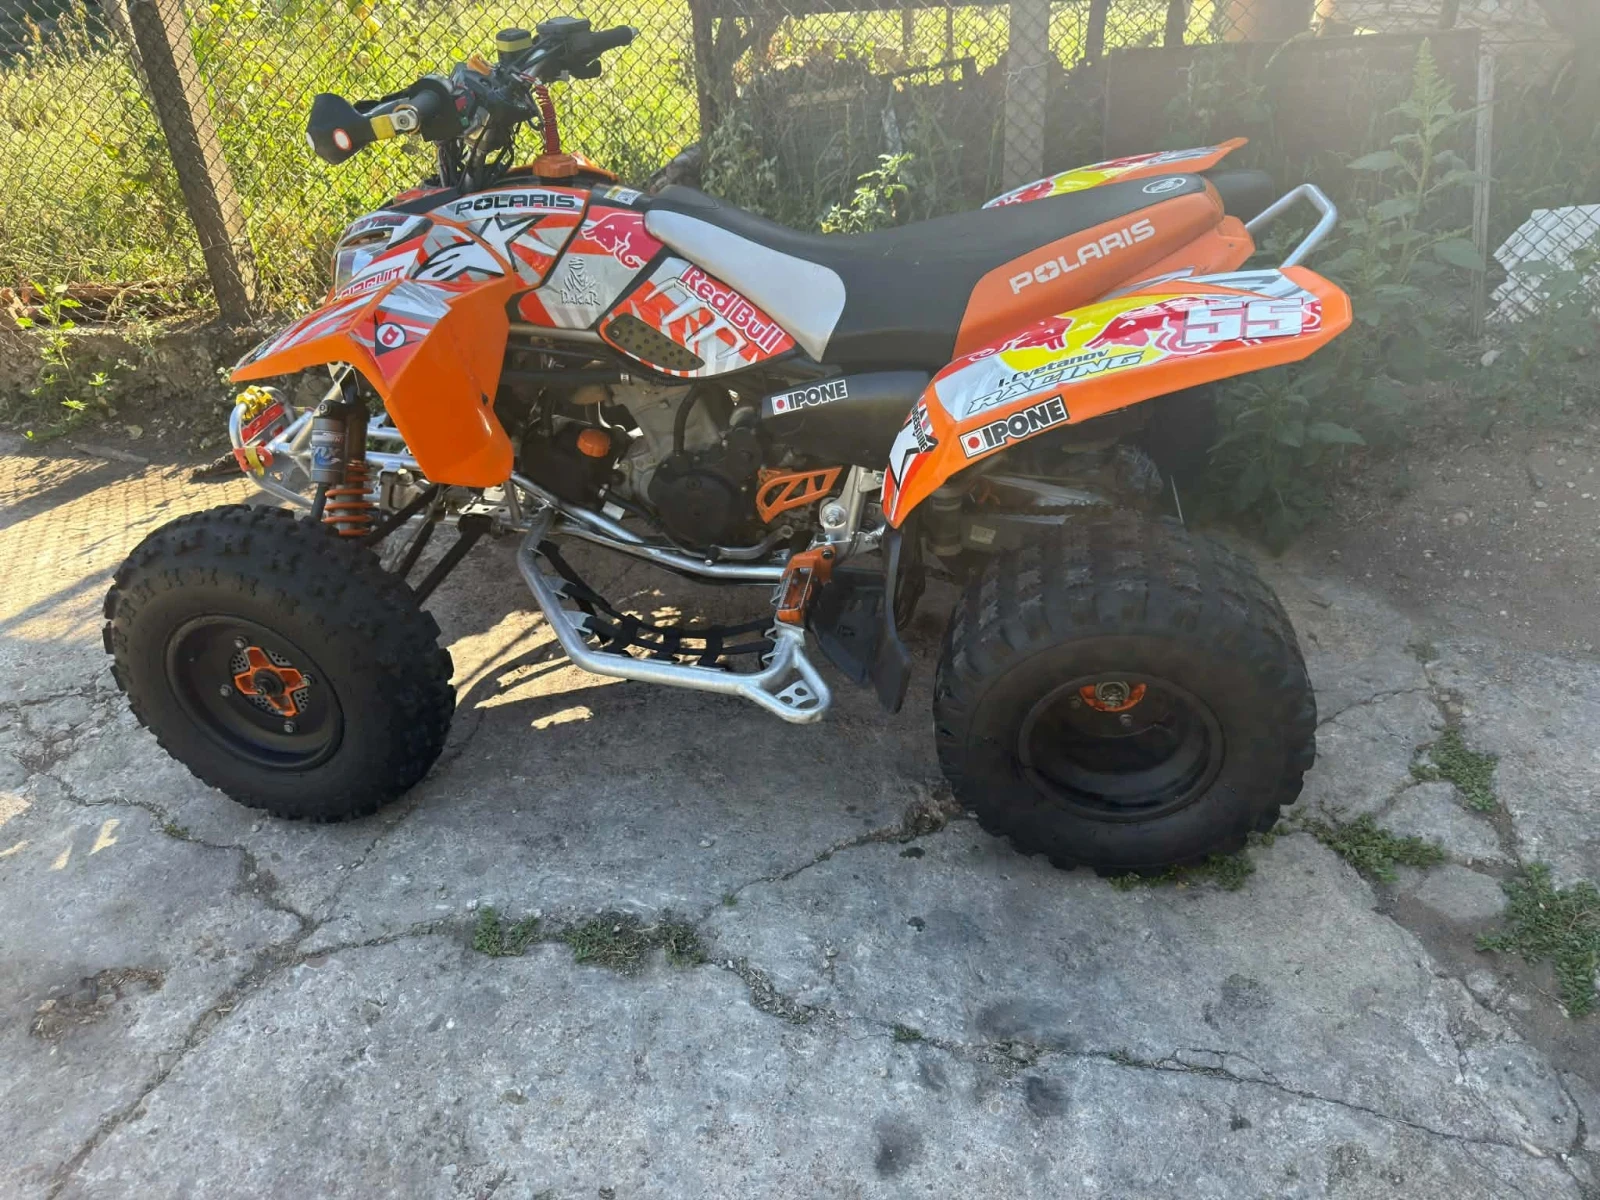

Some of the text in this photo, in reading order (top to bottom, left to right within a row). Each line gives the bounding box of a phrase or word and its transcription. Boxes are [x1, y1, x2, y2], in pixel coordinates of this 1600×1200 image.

[455, 193, 576, 216] POLARIS
[1009, 218, 1156, 295] POLARIS
[560, 289, 601, 307] DAKAR
[1182, 297, 1304, 347] 55
[787, 380, 848, 411] IPONE
[967, 350, 1146, 415] RACING
[982, 397, 1069, 448] IPONE
